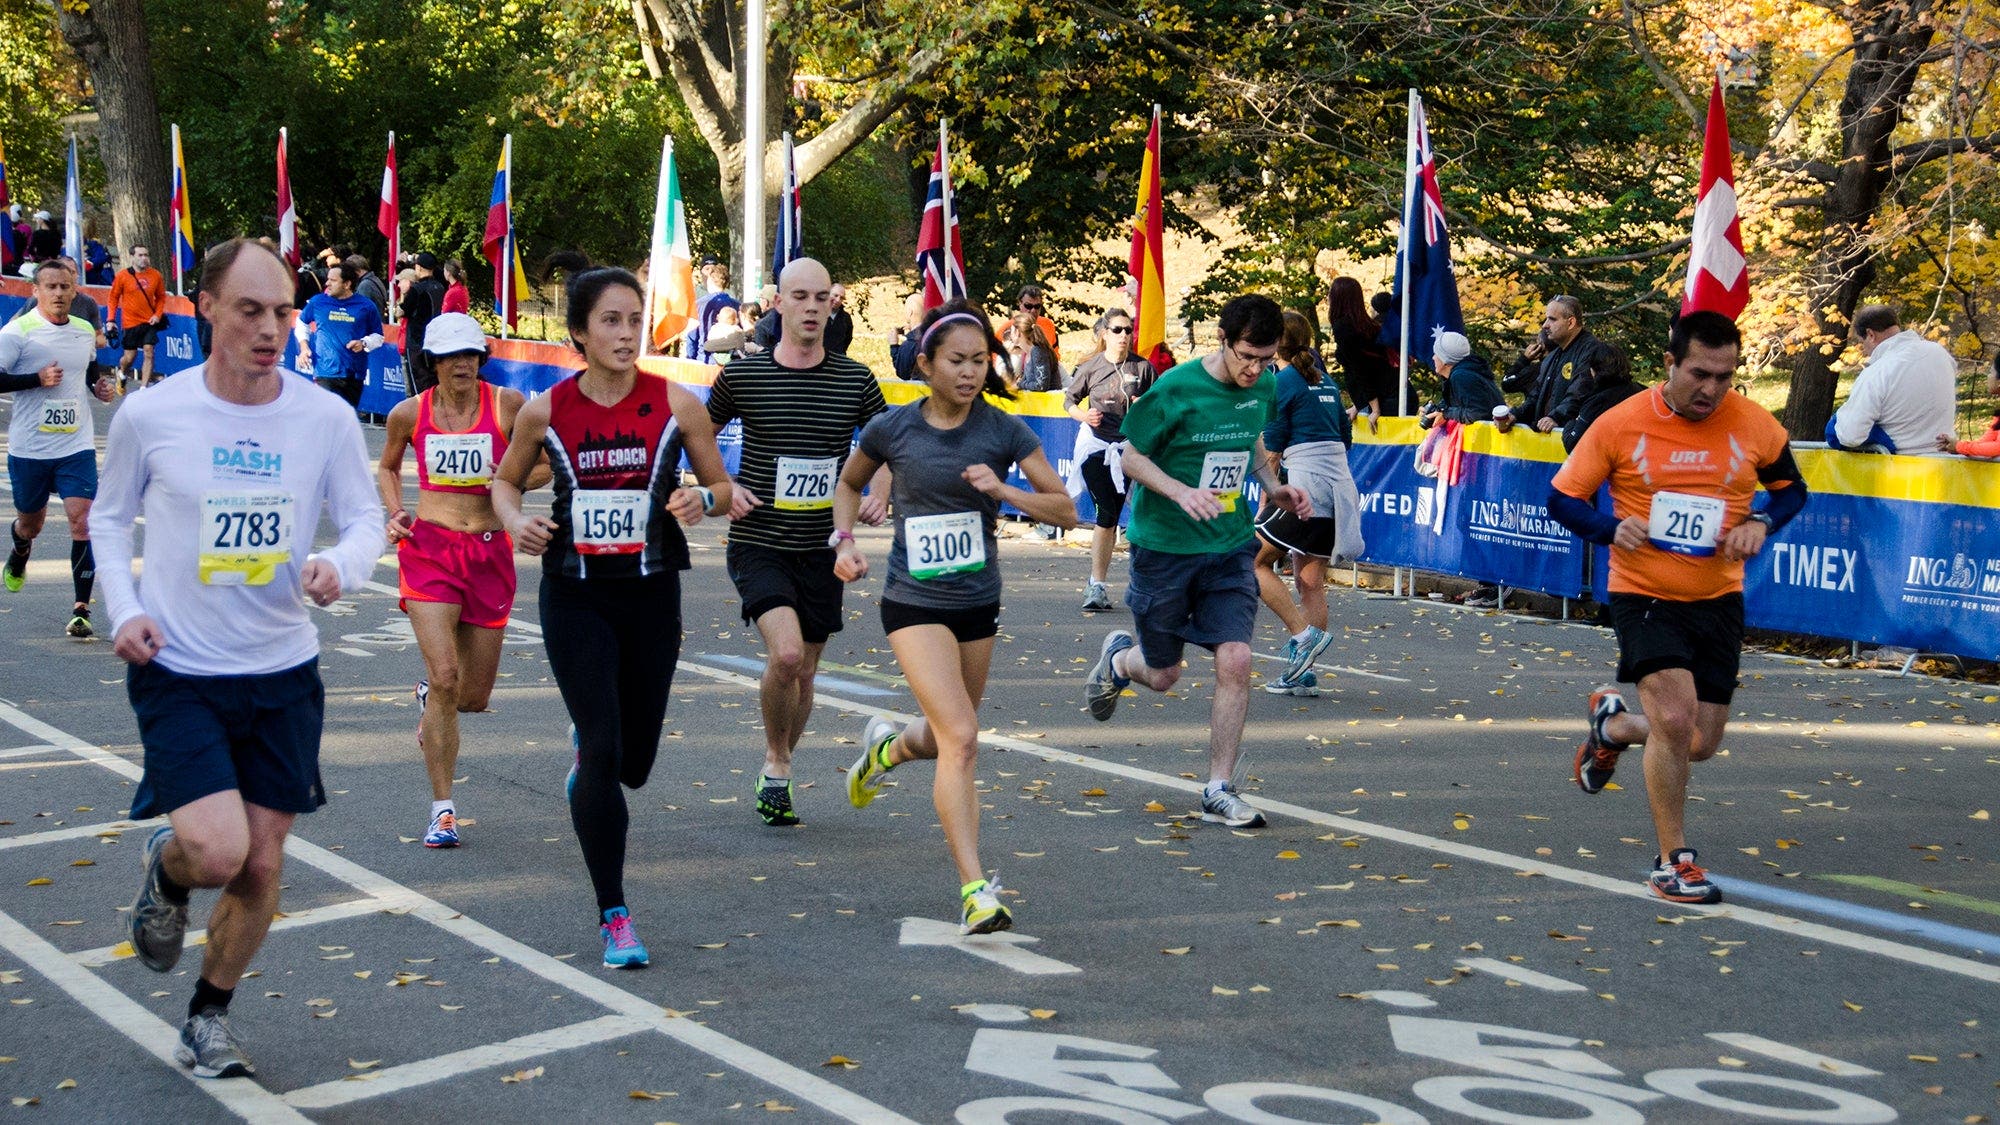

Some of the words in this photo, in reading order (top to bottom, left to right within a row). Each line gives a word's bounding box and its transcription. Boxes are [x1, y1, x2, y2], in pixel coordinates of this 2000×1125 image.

[166, 336, 182, 359] ING
[44, 409, 76, 425] 2630
[212, 446, 282, 471] DASH
[435, 449, 482, 474] 2470
[578, 450, 604, 469] CITY
[608, 447, 647, 467] COACH
[1670, 450, 1709, 463] URT
[784, 473, 829, 498] 2726
[1209, 465, 1242, 489] 2752
[1469, 499, 1499, 527] ING
[1521, 503, 1537, 516] NEW
[214, 511, 281, 548] 2783
[583, 508, 635, 539] 1564
[1664, 510, 1705, 541] 216
[919, 530, 972, 564] 3100
[1773, 542, 1857, 593] TIMEX
[1906, 556, 1947, 587] ING
[1902, 594, 1928, 605] PREMIER
[1929, 597, 1949, 606] EVENT
[1950, 600, 1959, 608] OF
[1962, 601, 1978, 610] NEW
